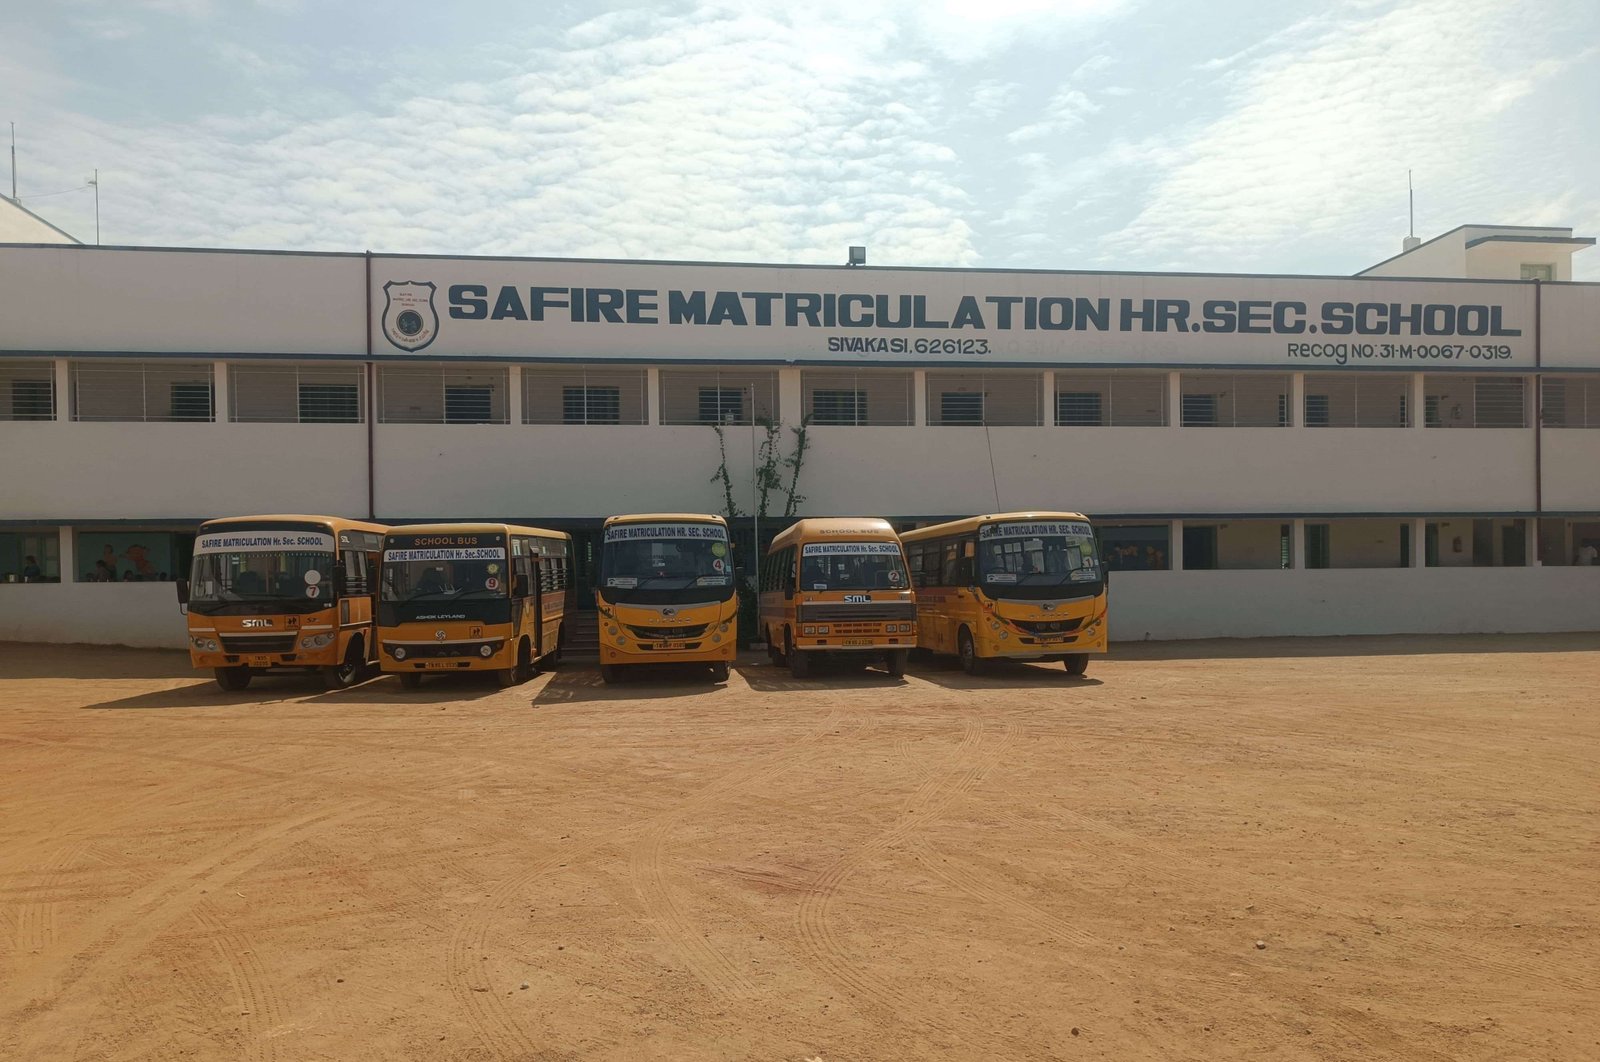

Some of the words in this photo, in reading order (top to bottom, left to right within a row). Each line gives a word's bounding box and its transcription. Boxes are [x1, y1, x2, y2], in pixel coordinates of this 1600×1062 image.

[448, 284, 659, 324] SAFIRE
[668, 290, 1111, 332] MATRICULATION
[607, 528, 628, 540] SAFIRE
[628, 527, 676, 539] MATRICULATION
[676, 526, 687, 537] HR.
[688, 527, 702, 537] SEC.
[702, 527, 725, 539] SCHOOL
[1003, 525, 1048, 536] MATRICULATION
[1071, 524, 1091, 536] SCHOOL
[202, 538, 222, 549] SAFIRE
[223, 537, 272, 548] MATRICULATION
[283, 536, 296, 546] Sec.
[297, 536, 324, 546] SCHOOL
[414, 537, 455, 546] SCHOOL
[457, 537, 478, 545] BUS
[804, 545, 822, 554] SAFIRE
[822, 544, 861, 554] MATRICULATION
[879, 544, 899, 553] SCHOOL
[388, 551, 408, 561] SAFIRE
[408, 549, 455, 561] MATRICULATION
[715, 560, 721, 570] 4
[890, 572, 898, 581] 2
[488, 578, 496, 587] 9
[309, 587, 316, 596] 7
